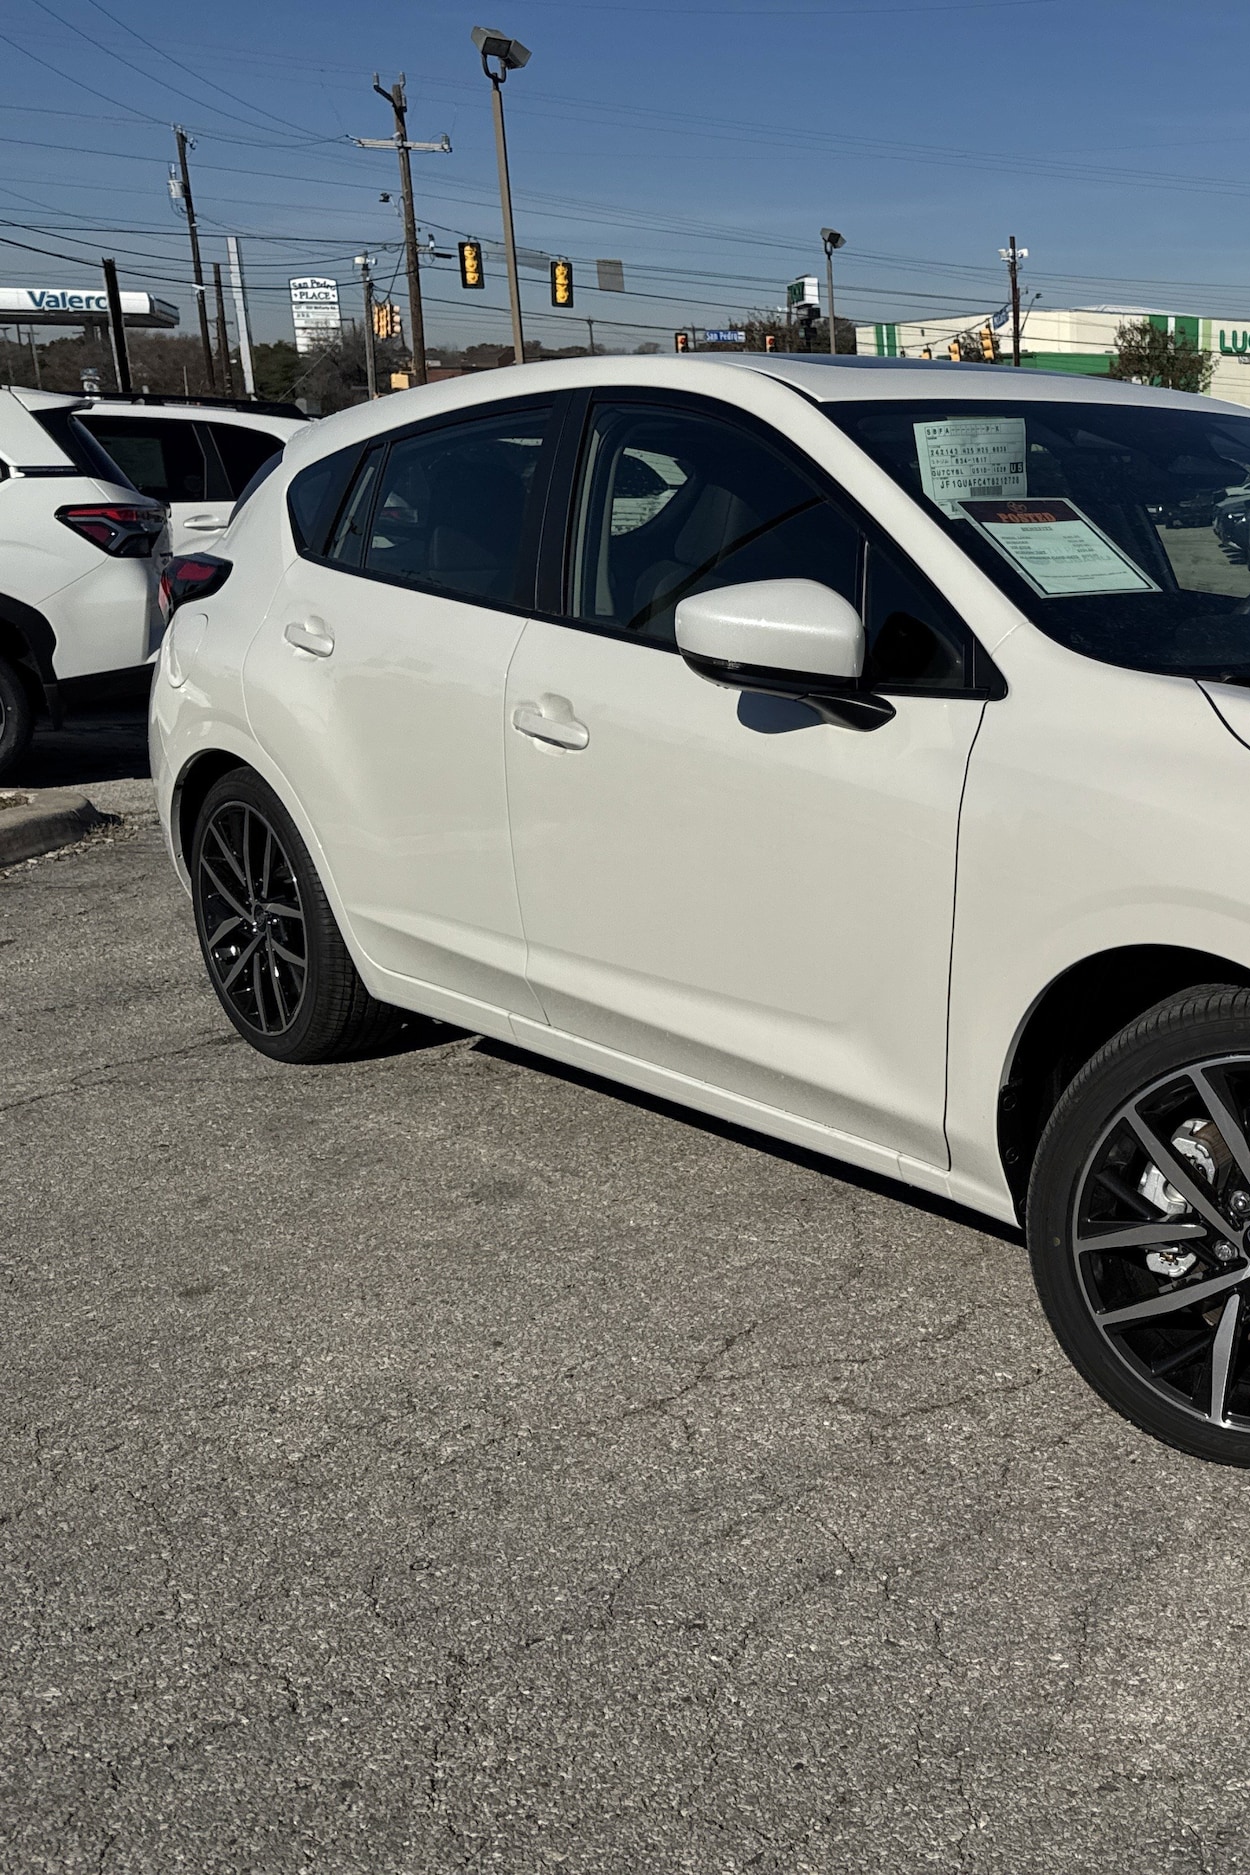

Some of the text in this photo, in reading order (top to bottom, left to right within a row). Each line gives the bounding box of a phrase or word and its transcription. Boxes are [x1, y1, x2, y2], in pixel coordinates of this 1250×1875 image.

[299, 291, 331, 300] PLACE
[706, 331, 718, 341] San
[996, 512, 1056, 523] POSTED
